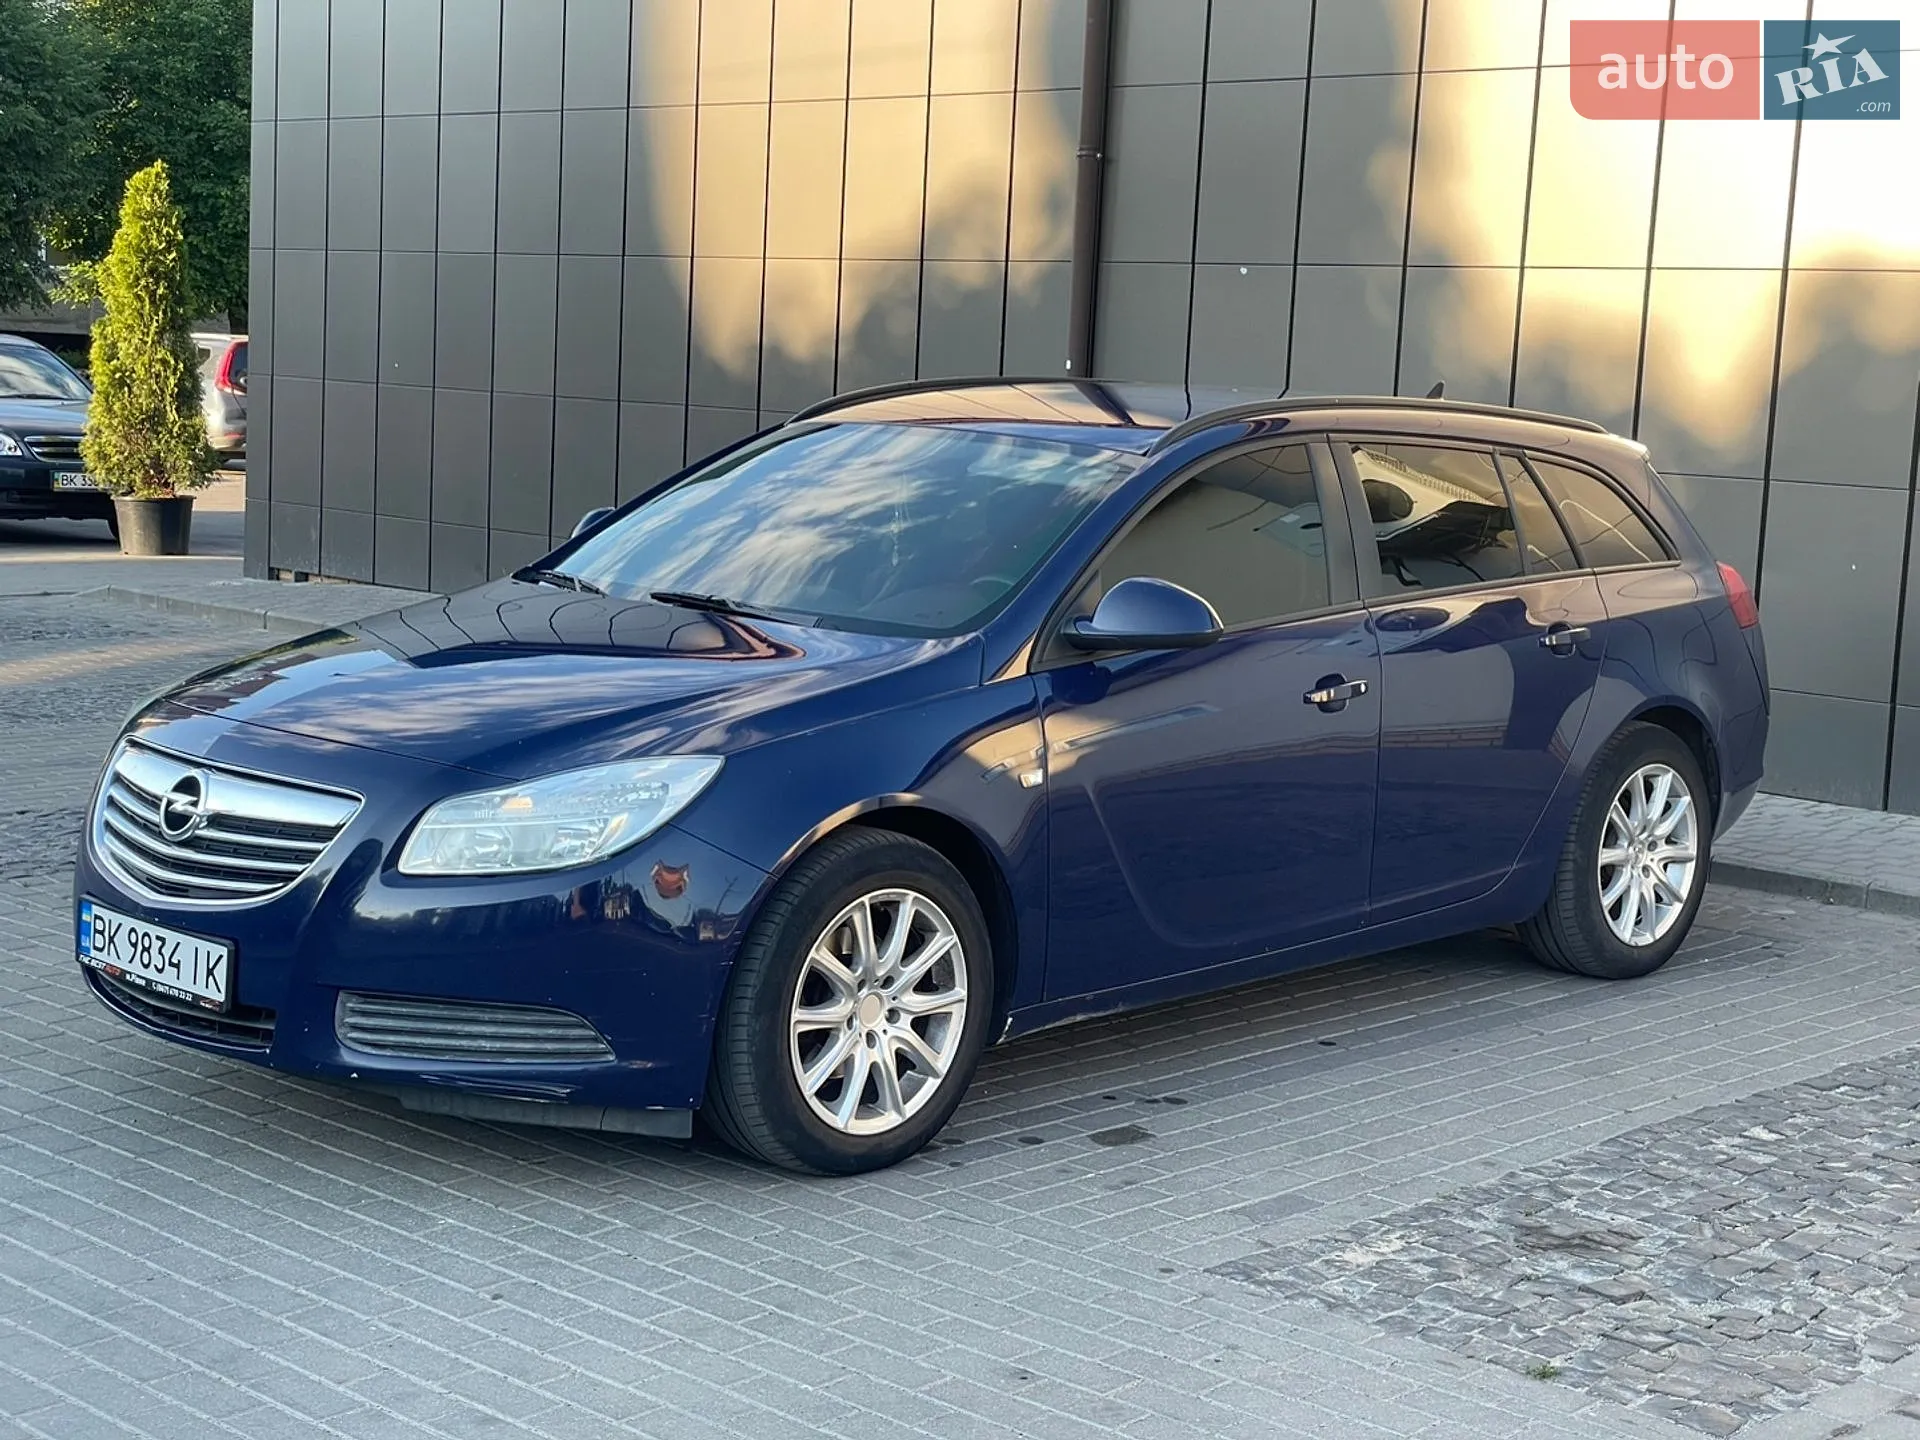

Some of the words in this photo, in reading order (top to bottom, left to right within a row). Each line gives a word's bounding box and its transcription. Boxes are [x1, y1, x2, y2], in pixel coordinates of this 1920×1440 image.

[61, 474, 77, 487] BK
[93, 914, 122, 960] BK
[127, 926, 181, 981] 9834
[193, 946, 224, 994] IK
